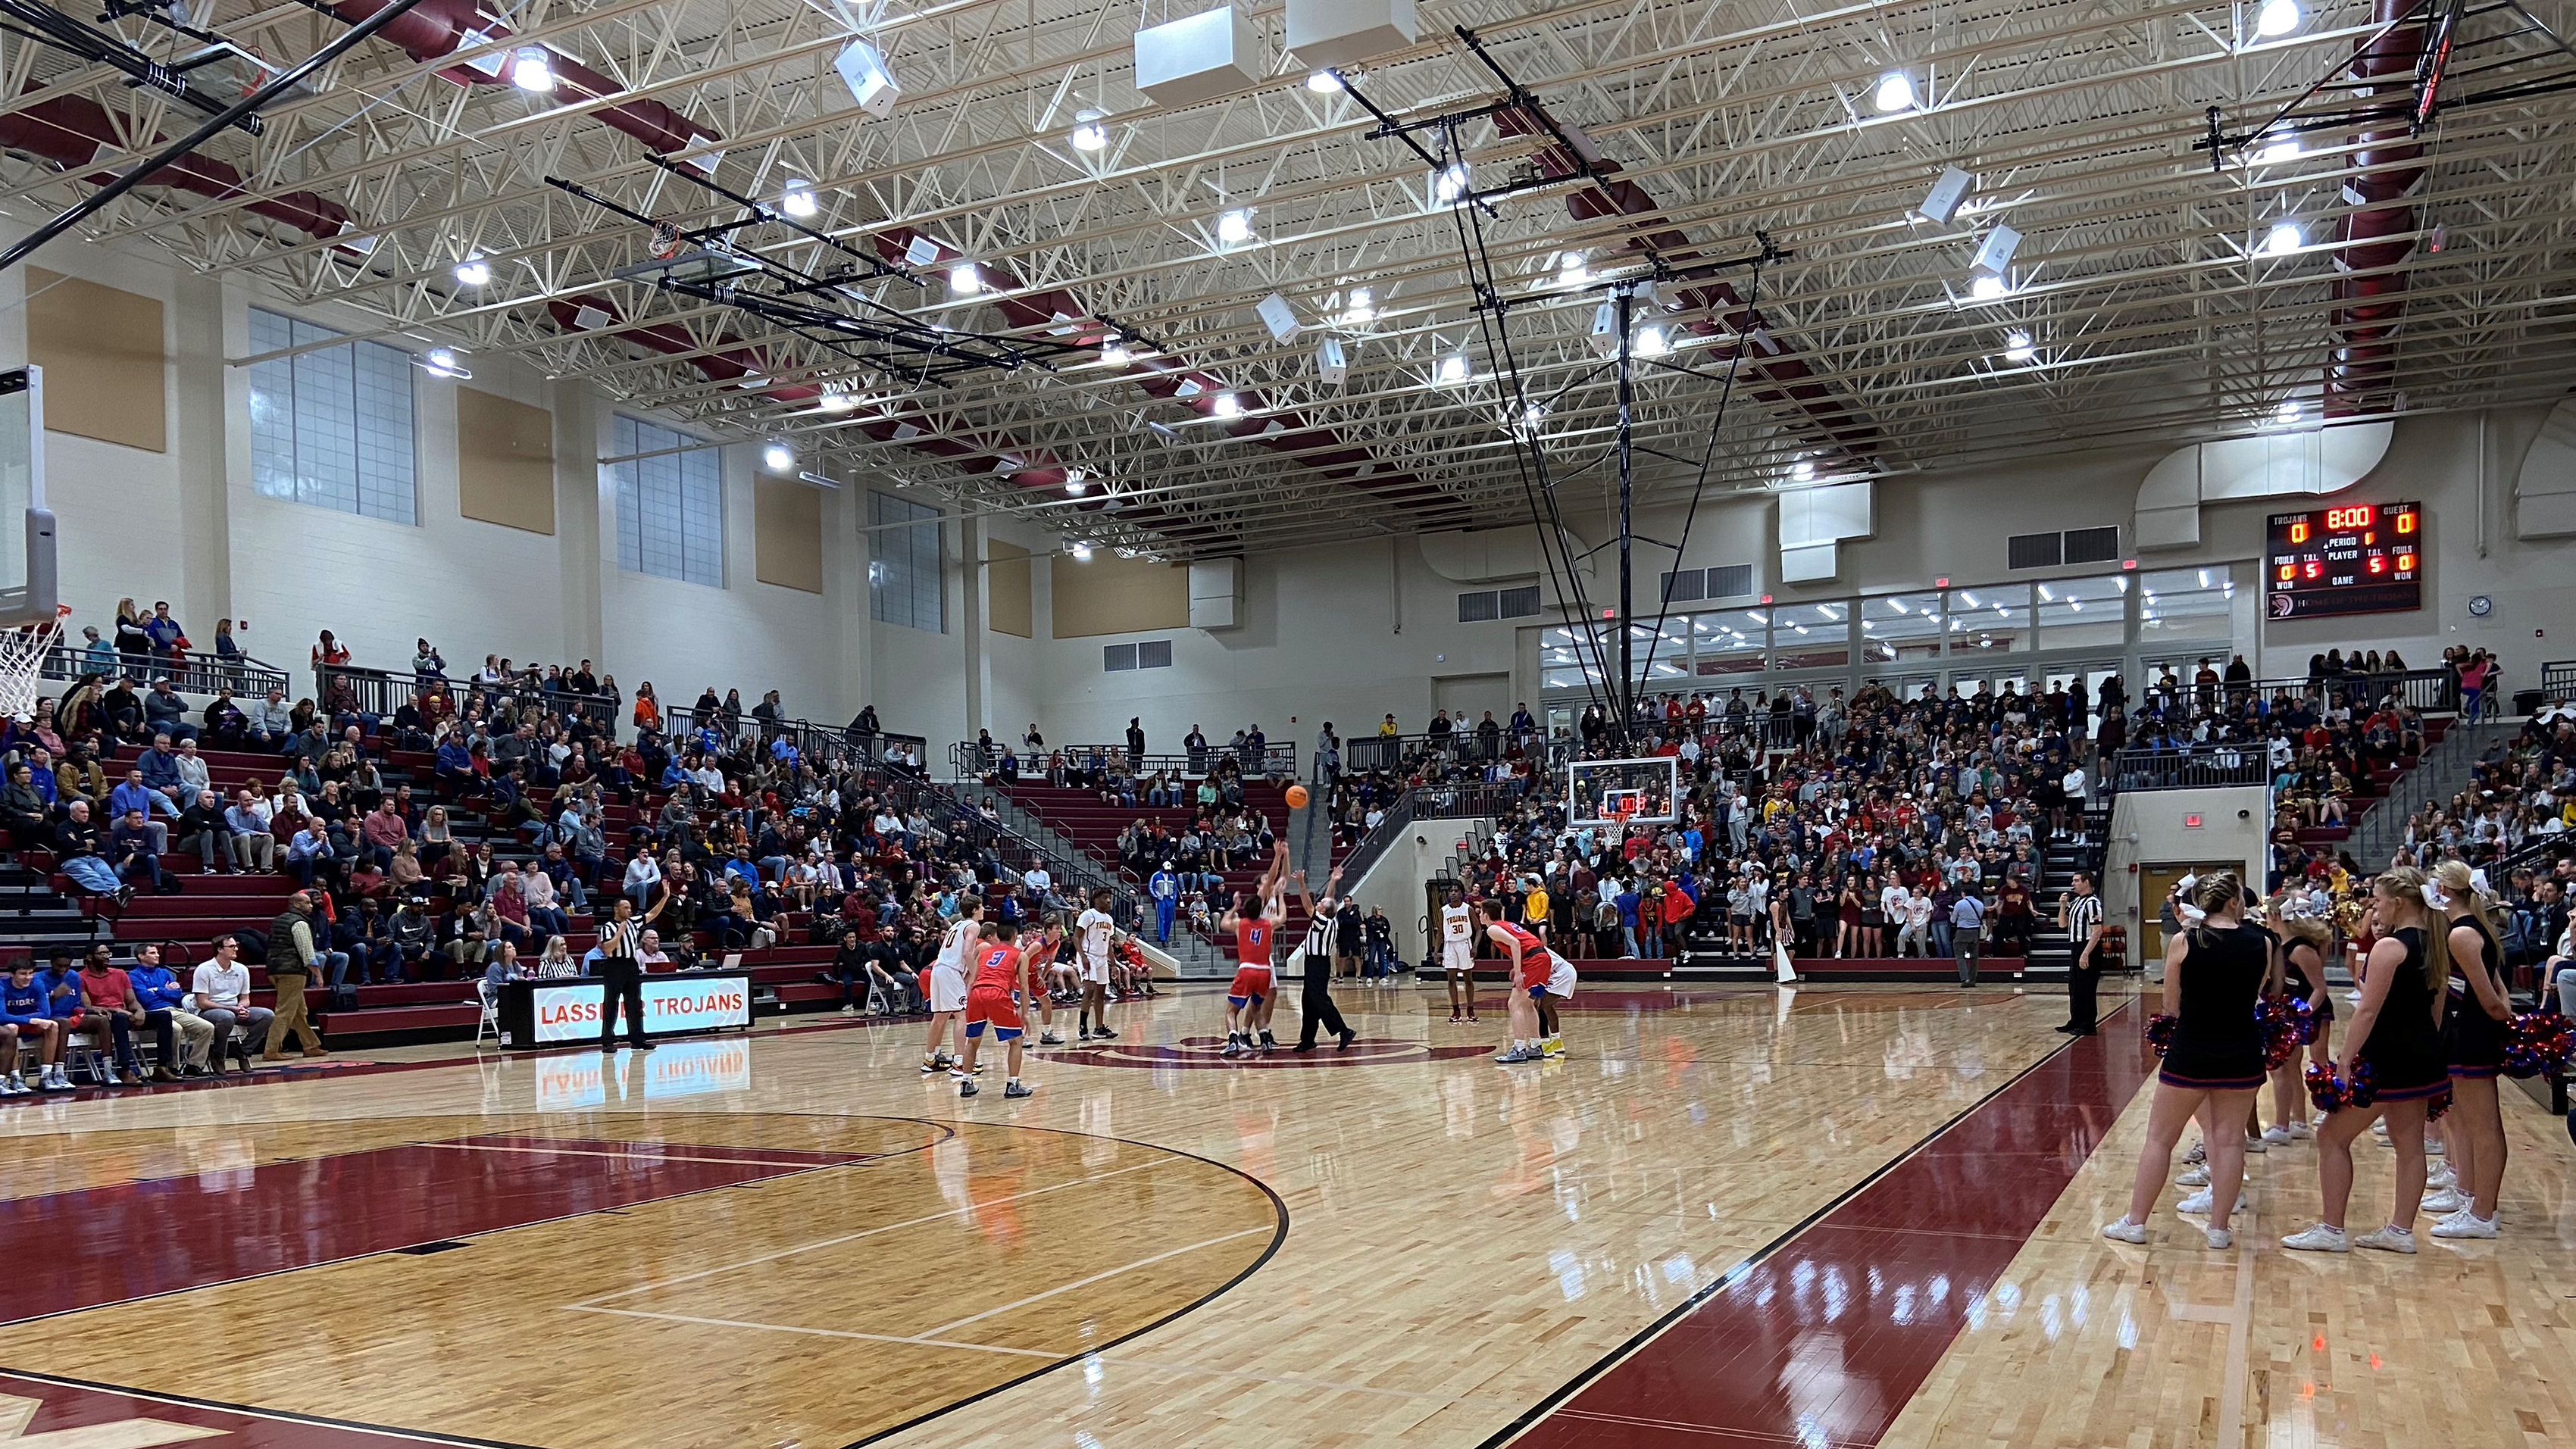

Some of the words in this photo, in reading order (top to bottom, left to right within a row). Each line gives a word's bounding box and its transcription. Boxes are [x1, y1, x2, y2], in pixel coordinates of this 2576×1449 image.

[2384, 505, 2409, 515] GUEST
[2274, 514, 2307, 525] TROJANS
[2328, 507, 2368, 529] 8:00
[2398, 514, 2410, 533] 0
[2291, 524, 2304, 543] 0
[2329, 537, 2356, 547] PERIOD
[2393, 545, 2412, 554] FOULS
[2274, 555, 2294, 565] FOULS
[2328, 550, 2358, 561] PLAYER
[2370, 557, 2381, 573] 5
[2399, 555, 2410, 570] 0
[2281, 566, 2290, 580] 0
[2306, 564, 2317, 578] 5
[2394, 572, 2411, 580] WON
[2276, 581, 2293, 590] WON
[2332, 576, 2354, 586] GAME
[1452, 924, 1464, 935] 30
[1249, 928, 1263, 945] 4
[986, 951, 1007, 967] 3
[653, 993, 743, 1016] TROJANS
